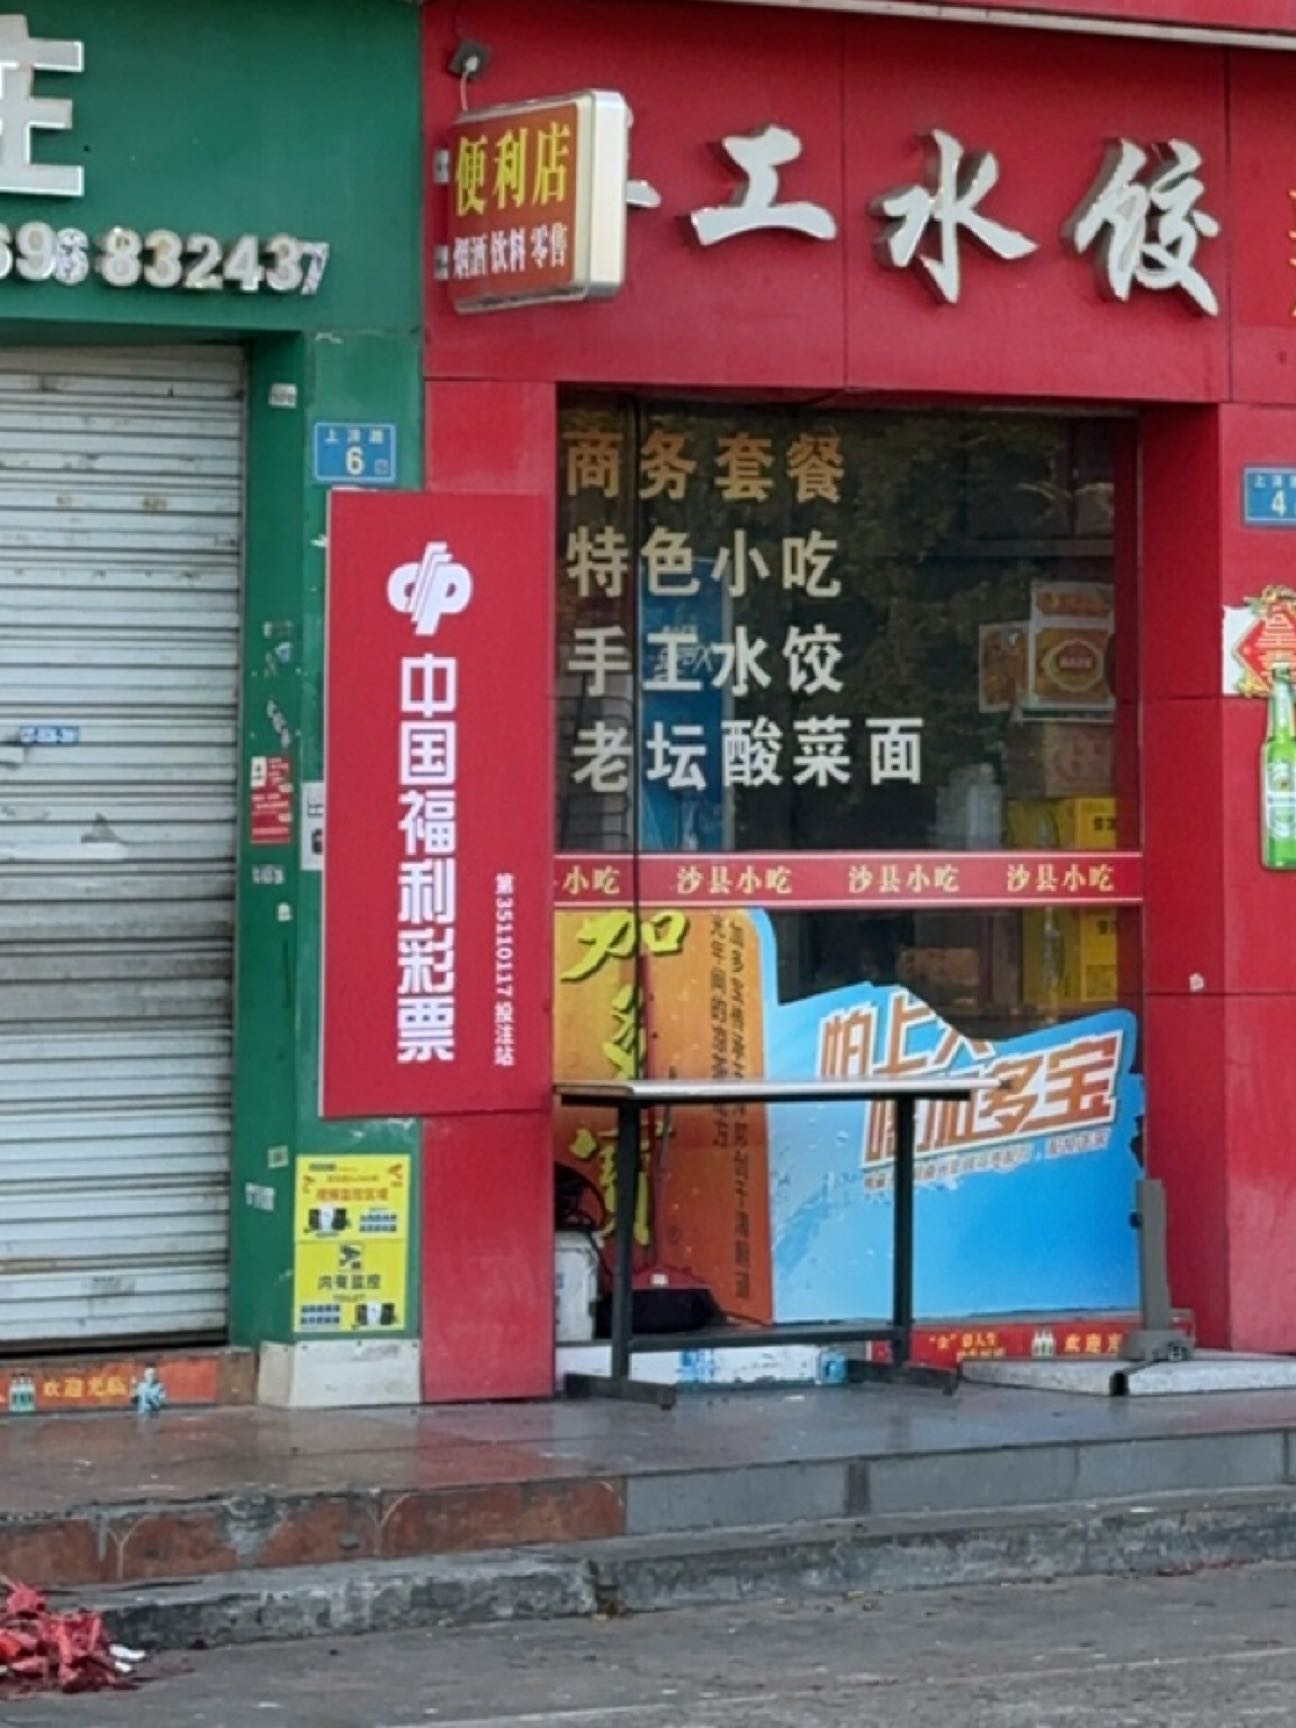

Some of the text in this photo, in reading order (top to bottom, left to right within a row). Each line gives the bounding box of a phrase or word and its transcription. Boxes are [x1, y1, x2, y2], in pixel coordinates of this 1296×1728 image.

[456, 121, 571, 218] 便利店
[627, 125, 1220, 317] 工水饺
[345, 445, 365, 476] 6
[562, 429, 843, 505] 商务套餐
[1270, 489, 1288, 518] 4
[567, 525, 842, 598] 特色小吃
[568, 624, 843, 696] 手工水饺
[573, 715, 923, 793] 老坛酸菜面
[397, 652, 458, 1064] 中国福利彩票
[677, 865, 793, 894] 沙县小吃
[848, 864, 959, 894] 沙县小吃
[1007, 863, 1115, 893] 沙县小吃
